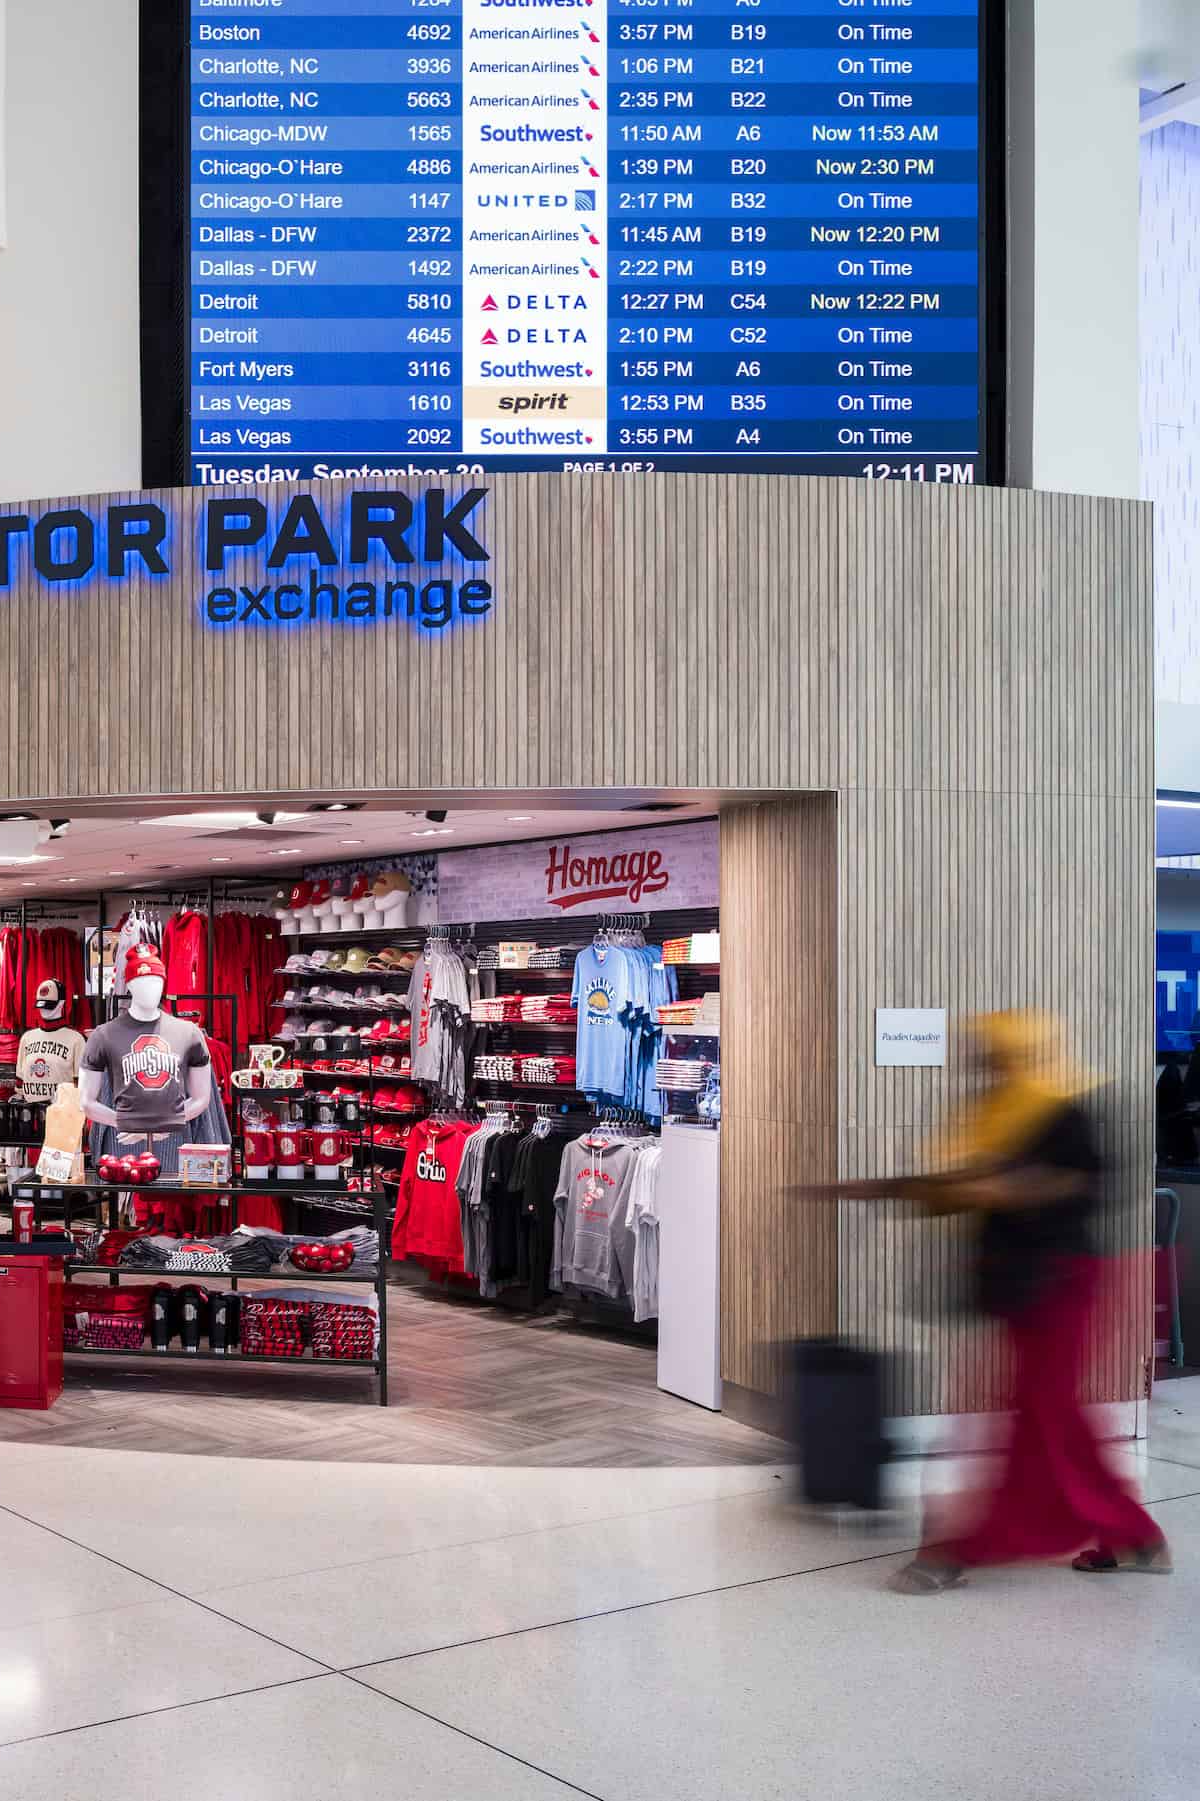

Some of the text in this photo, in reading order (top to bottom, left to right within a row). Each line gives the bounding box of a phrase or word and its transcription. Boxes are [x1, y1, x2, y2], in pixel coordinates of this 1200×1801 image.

[199, 25, 260, 41] Boston
[406, 25, 451, 40] 4692
[620, 25, 658, 40] 3:57
[663, 25, 693, 41] PM
[731, 25, 766, 41] B19
[838, 25, 865, 40] On
[868, 25, 913, 41] Time
[199, 59, 284, 76] Charlotte,
[290, 59, 319, 74] NC
[407, 59, 451, 74] 3936
[621, 59, 658, 74] 1:06
[663, 59, 693, 74] PM
[731, 59, 764, 74] B21
[837, 59, 864, 74] On
[868, 58, 913, 74] Time
[199, 92, 284, 110] Charlotte,
[290, 93, 318, 108] NC
[407, 92, 451, 108] 5663
[619, 92, 659, 108] 2:35
[663, 92, 693, 108] PM
[731, 92, 766, 108] B22
[838, 92, 865, 108] On
[868, 92, 913, 108] Time
[199, 124, 938, 145] Chicago-MDW 1565 Southwest 11:50 AM A6 Now 11:53 AM
[406, 160, 452, 175] 4886
[621, 160, 658, 175] 1:39
[663, 160, 693, 175] PM
[731, 160, 766, 175] B20
[816, 160, 857, 175] Now
[860, 159, 900, 175] 2:30
[904, 159, 934, 175] PM
[409, 193, 451, 209] 1147
[478, 195, 568, 207] UNITED
[619, 193, 658, 209] 2:17
[663, 193, 693, 209] PM
[731, 193, 766, 209] B32
[837, 193, 864, 209] On
[868, 193, 913, 209] Time
[199, 227, 254, 242] Dallas
[271, 227, 317, 242] DFW
[407, 227, 451, 243] 2372
[621, 227, 668, 242] 11:45
[671, 227, 701, 242] AM
[731, 227, 767, 242] B19
[811, 227, 851, 242] Now
[856, 227, 905, 242] 12:20
[910, 227, 940, 242] PM
[199, 261, 254, 276] Dallas
[271, 261, 317, 276] DFW
[408, 261, 451, 276] 1492
[619, 261, 658, 276] 2:22
[663, 261, 693, 276] PM
[731, 261, 767, 276] B19
[837, 261, 864, 276] On
[868, 260, 913, 276] Time
[199, 294, 940, 310] Detroit 5810 DELTA 12:27 PM C54 Now 12:22 PM
[199, 328, 913, 344] Detroit 4645 DELTA 2:10 PM C52 On Time
[199, 360, 913, 381] Fort Myers 3116 Southwest 1:55 PM A6 On Time
[199, 393, 913, 415] Las Vegas 1610 spirit 12:53 PM B35 On Time
[199, 427, 913, 449] Las Vegas 2092 Southwest 3:55 PM A4 On Time
[935, 464, 974, 484] PM
[206, 488, 491, 570] PARK
[205, 569, 493, 630] exchange
[545, 846, 669, 908] Homage
[42, 1041, 70, 1060] STATE
